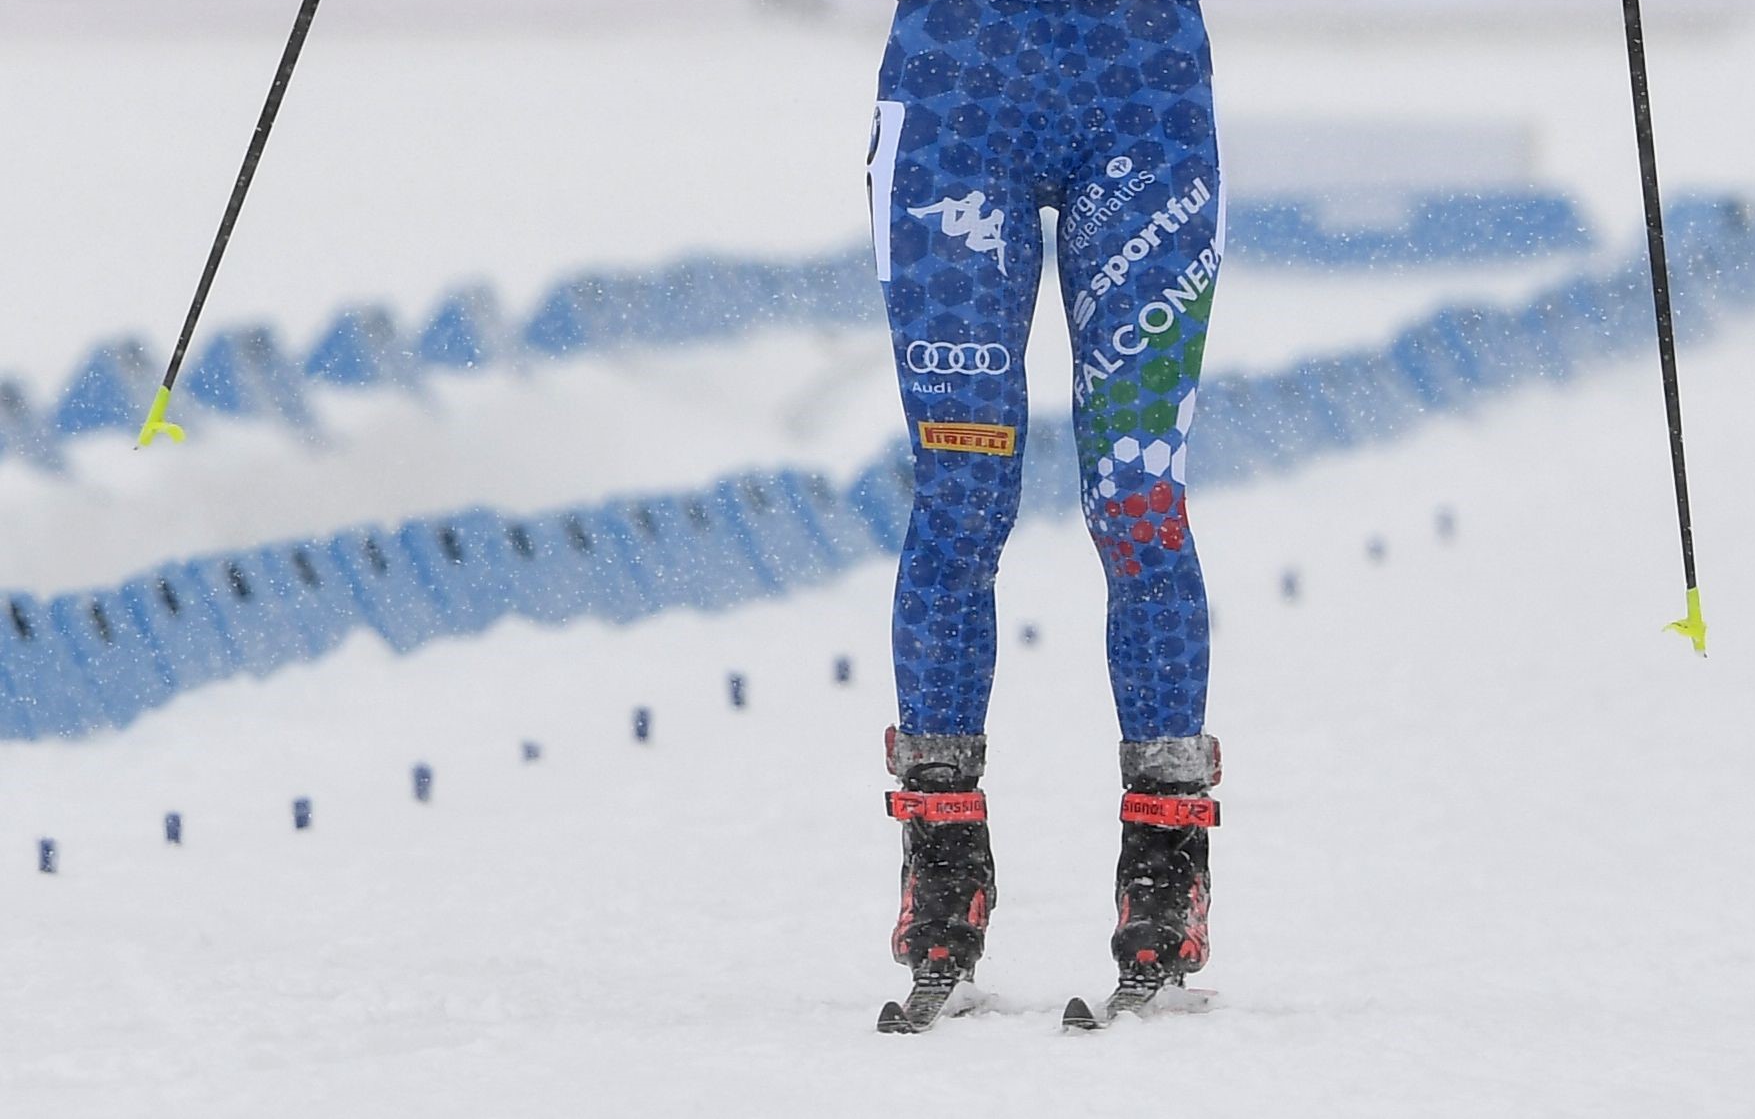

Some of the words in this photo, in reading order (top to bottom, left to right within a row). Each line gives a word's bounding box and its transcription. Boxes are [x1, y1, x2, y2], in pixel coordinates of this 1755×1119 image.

[1090, 177, 1212, 296] sportful
[912, 382, 952, 394] Audi
[924, 426, 1008, 451] PIRELLI
